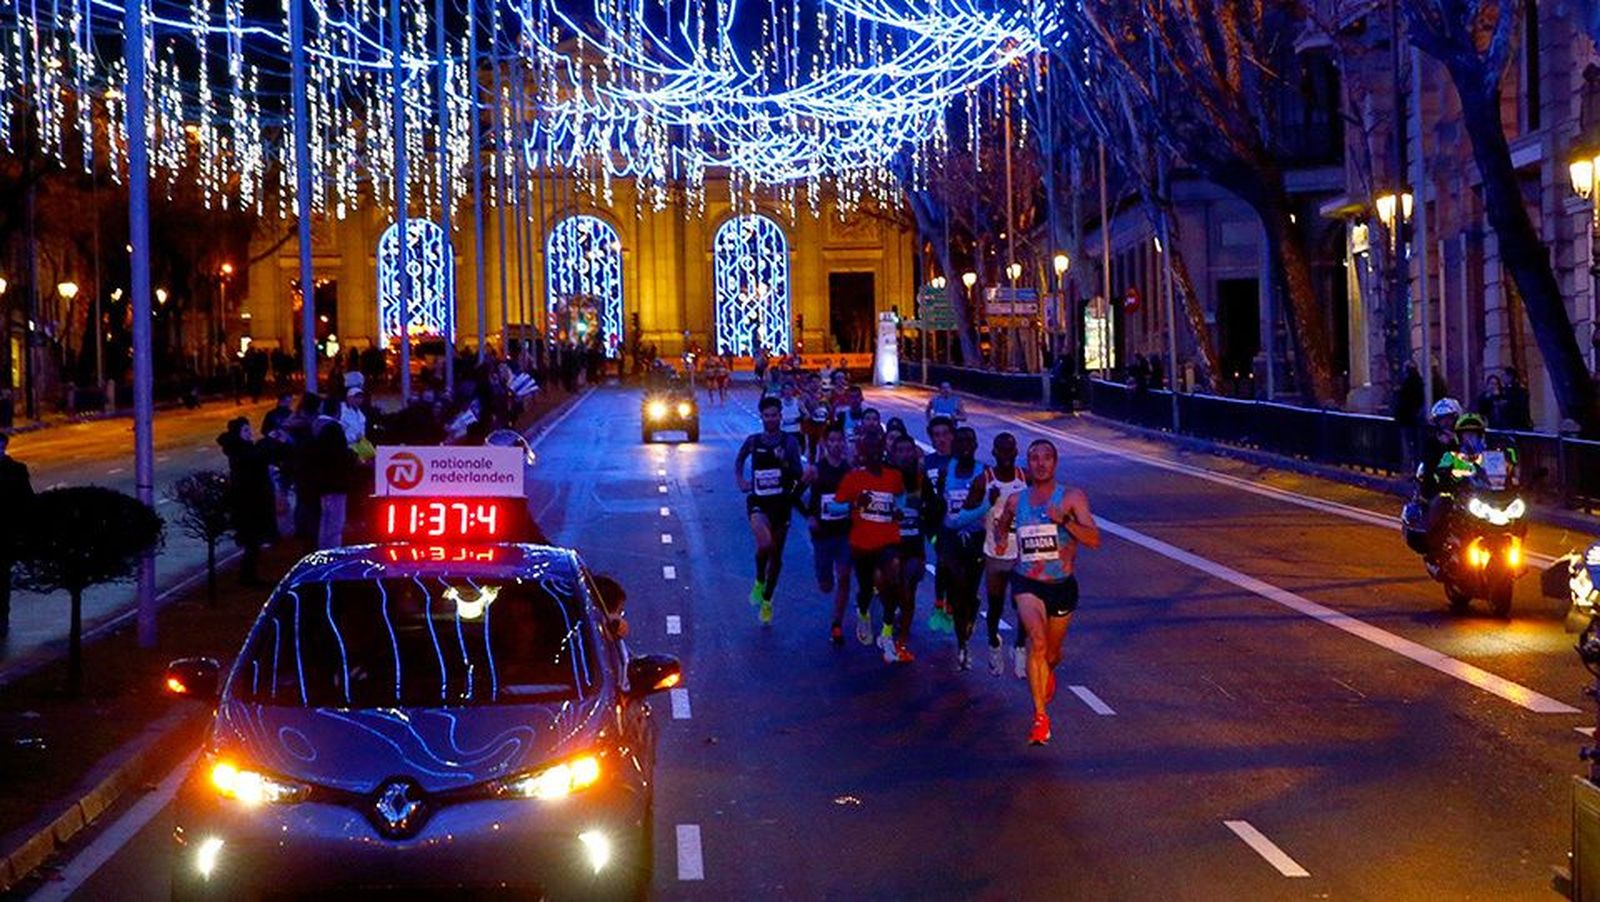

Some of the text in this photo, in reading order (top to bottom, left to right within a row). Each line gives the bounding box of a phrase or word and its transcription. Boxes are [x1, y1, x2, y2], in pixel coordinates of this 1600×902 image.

[430, 457, 493, 470] nationale
[430, 471, 514, 484] nederlanden
[387, 502, 497, 537] 11:37:4
